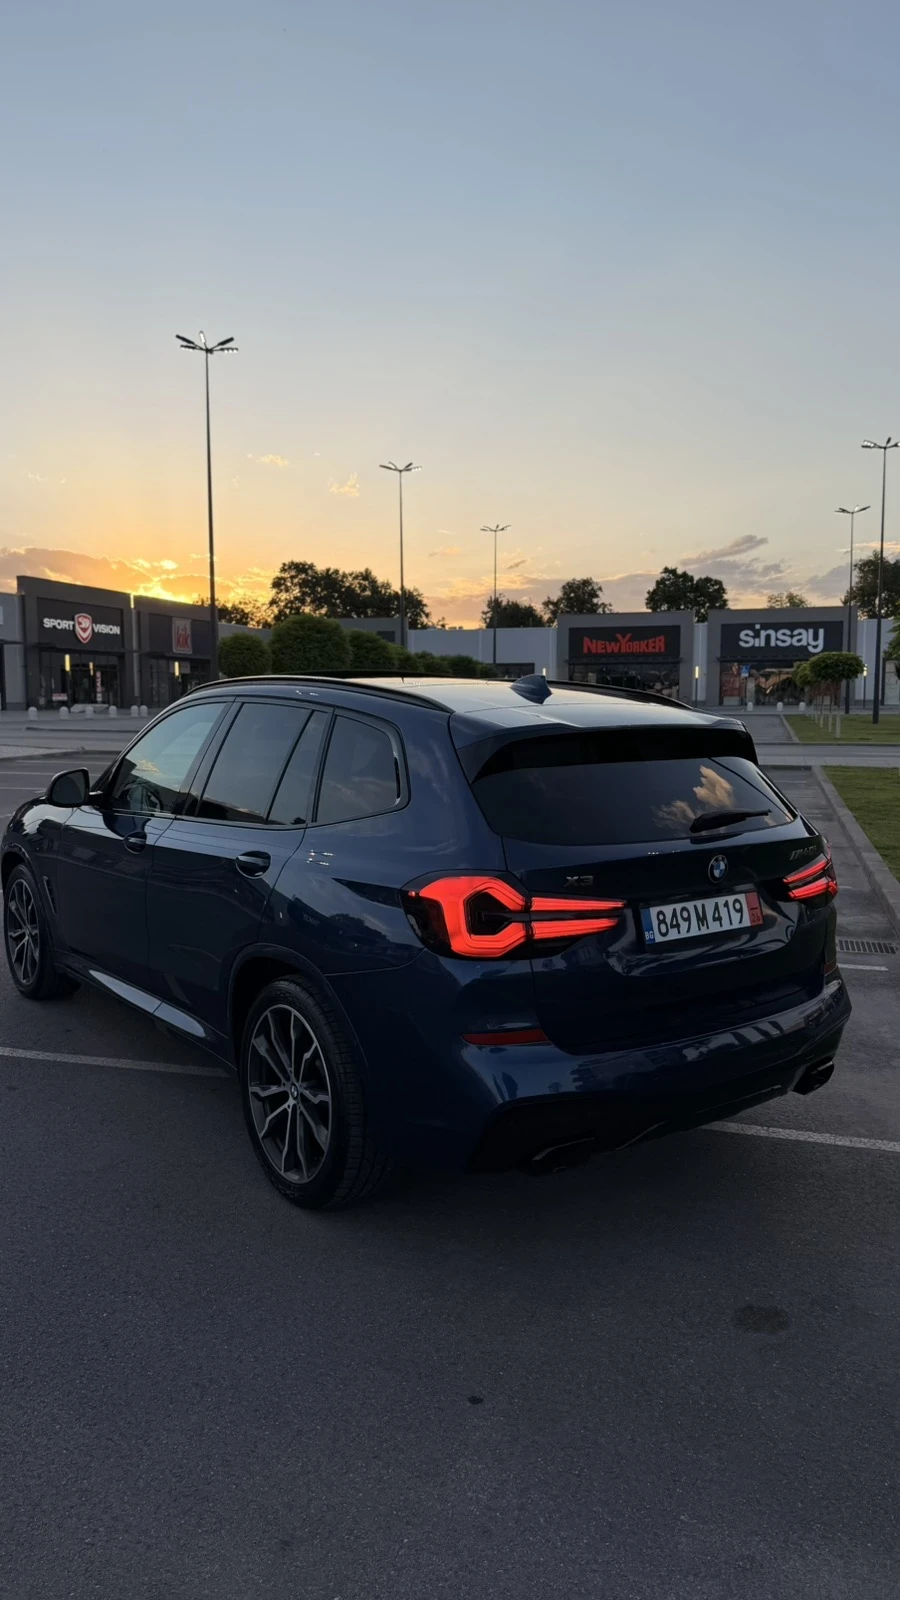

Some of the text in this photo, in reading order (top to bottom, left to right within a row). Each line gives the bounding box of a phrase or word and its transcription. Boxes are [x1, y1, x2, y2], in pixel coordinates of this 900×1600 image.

[43, 617, 120, 635] SPORT VISION
[738, 624, 824, 653] sinsay
[563, 875, 594, 888] X3
[645, 931, 654, 940] BG
